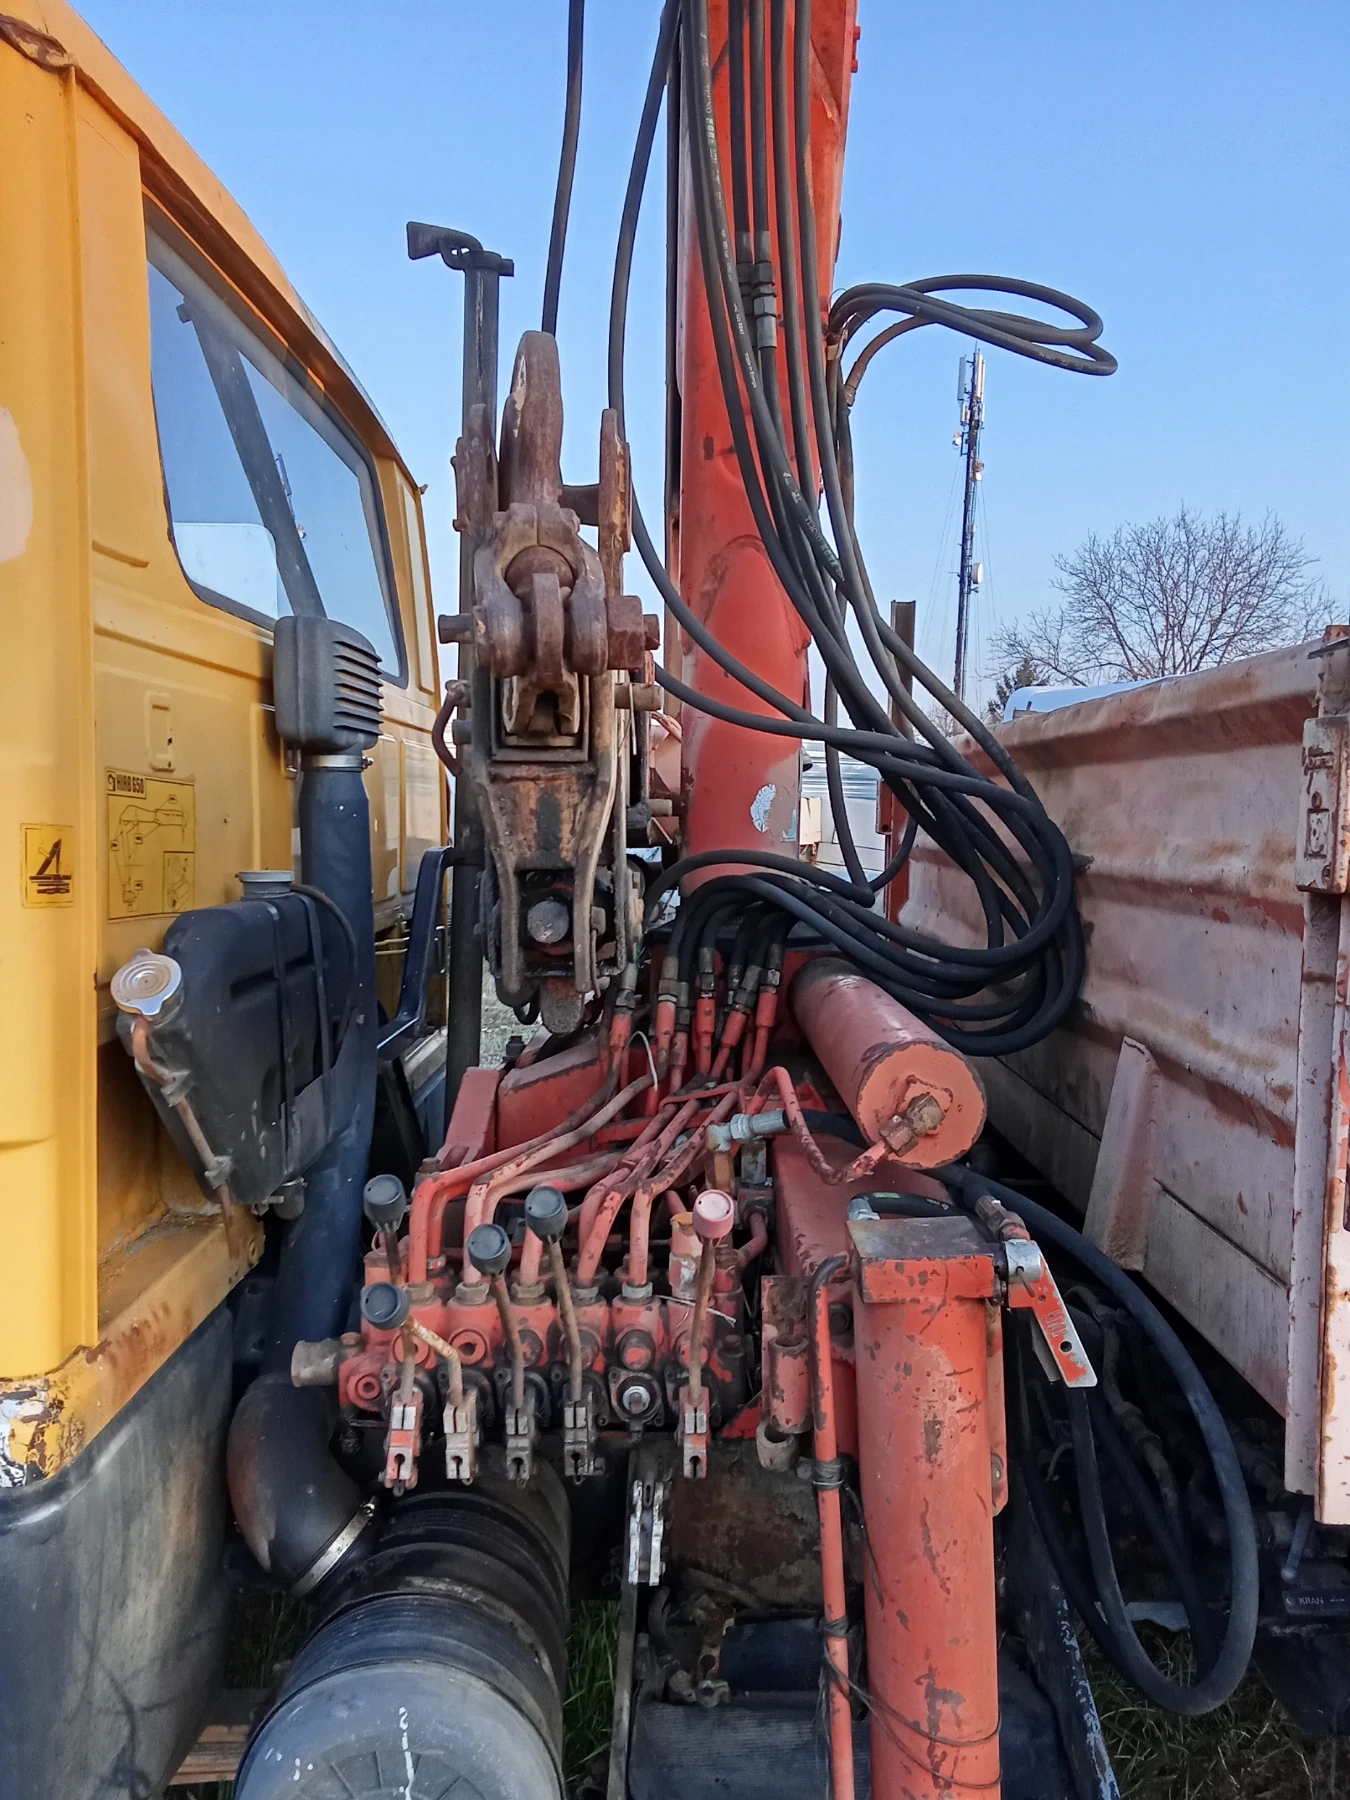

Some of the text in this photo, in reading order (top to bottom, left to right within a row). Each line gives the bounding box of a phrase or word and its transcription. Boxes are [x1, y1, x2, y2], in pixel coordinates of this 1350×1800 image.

[117, 774, 144, 794] HIAB 650
[1298, 1597, 1324, 1605] KRAN
